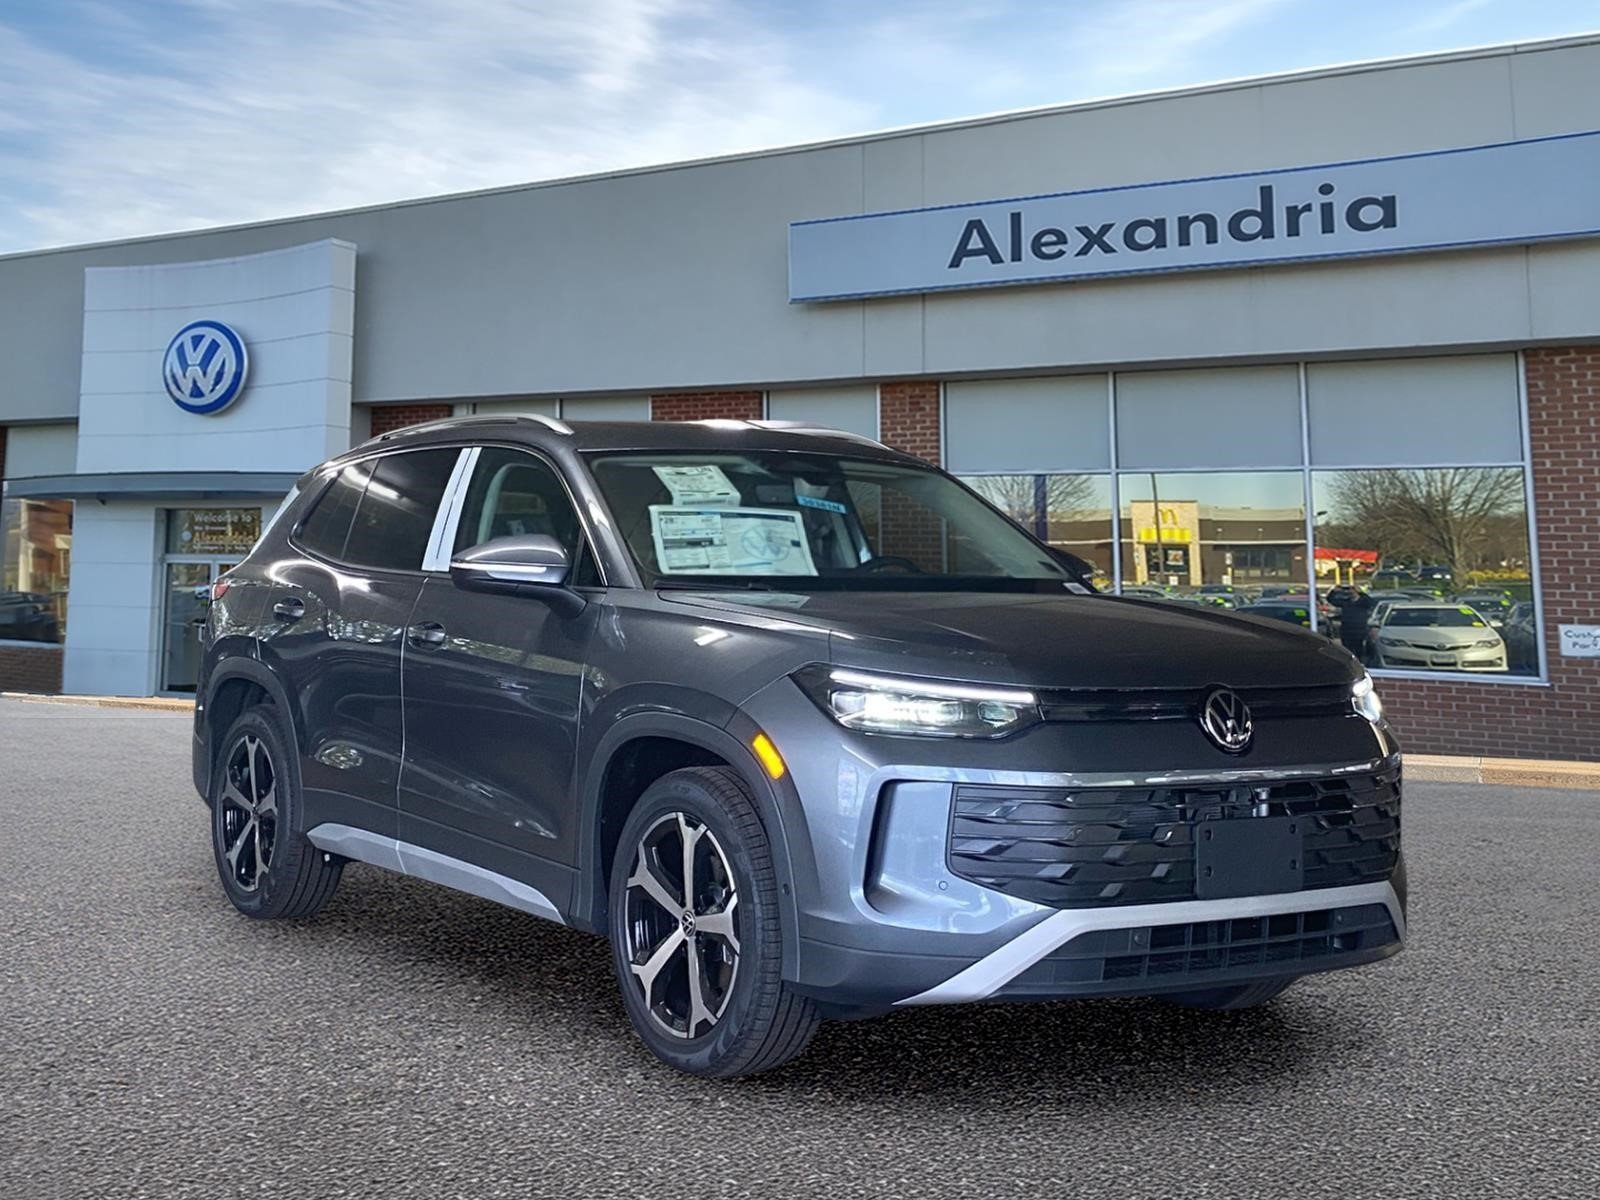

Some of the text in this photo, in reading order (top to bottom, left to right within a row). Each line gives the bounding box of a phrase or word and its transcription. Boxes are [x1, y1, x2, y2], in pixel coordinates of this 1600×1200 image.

[947, 183, 1399, 269] Alexandria
[164, 321, 244, 411] VW
[1206, 689, 1252, 749] VW
